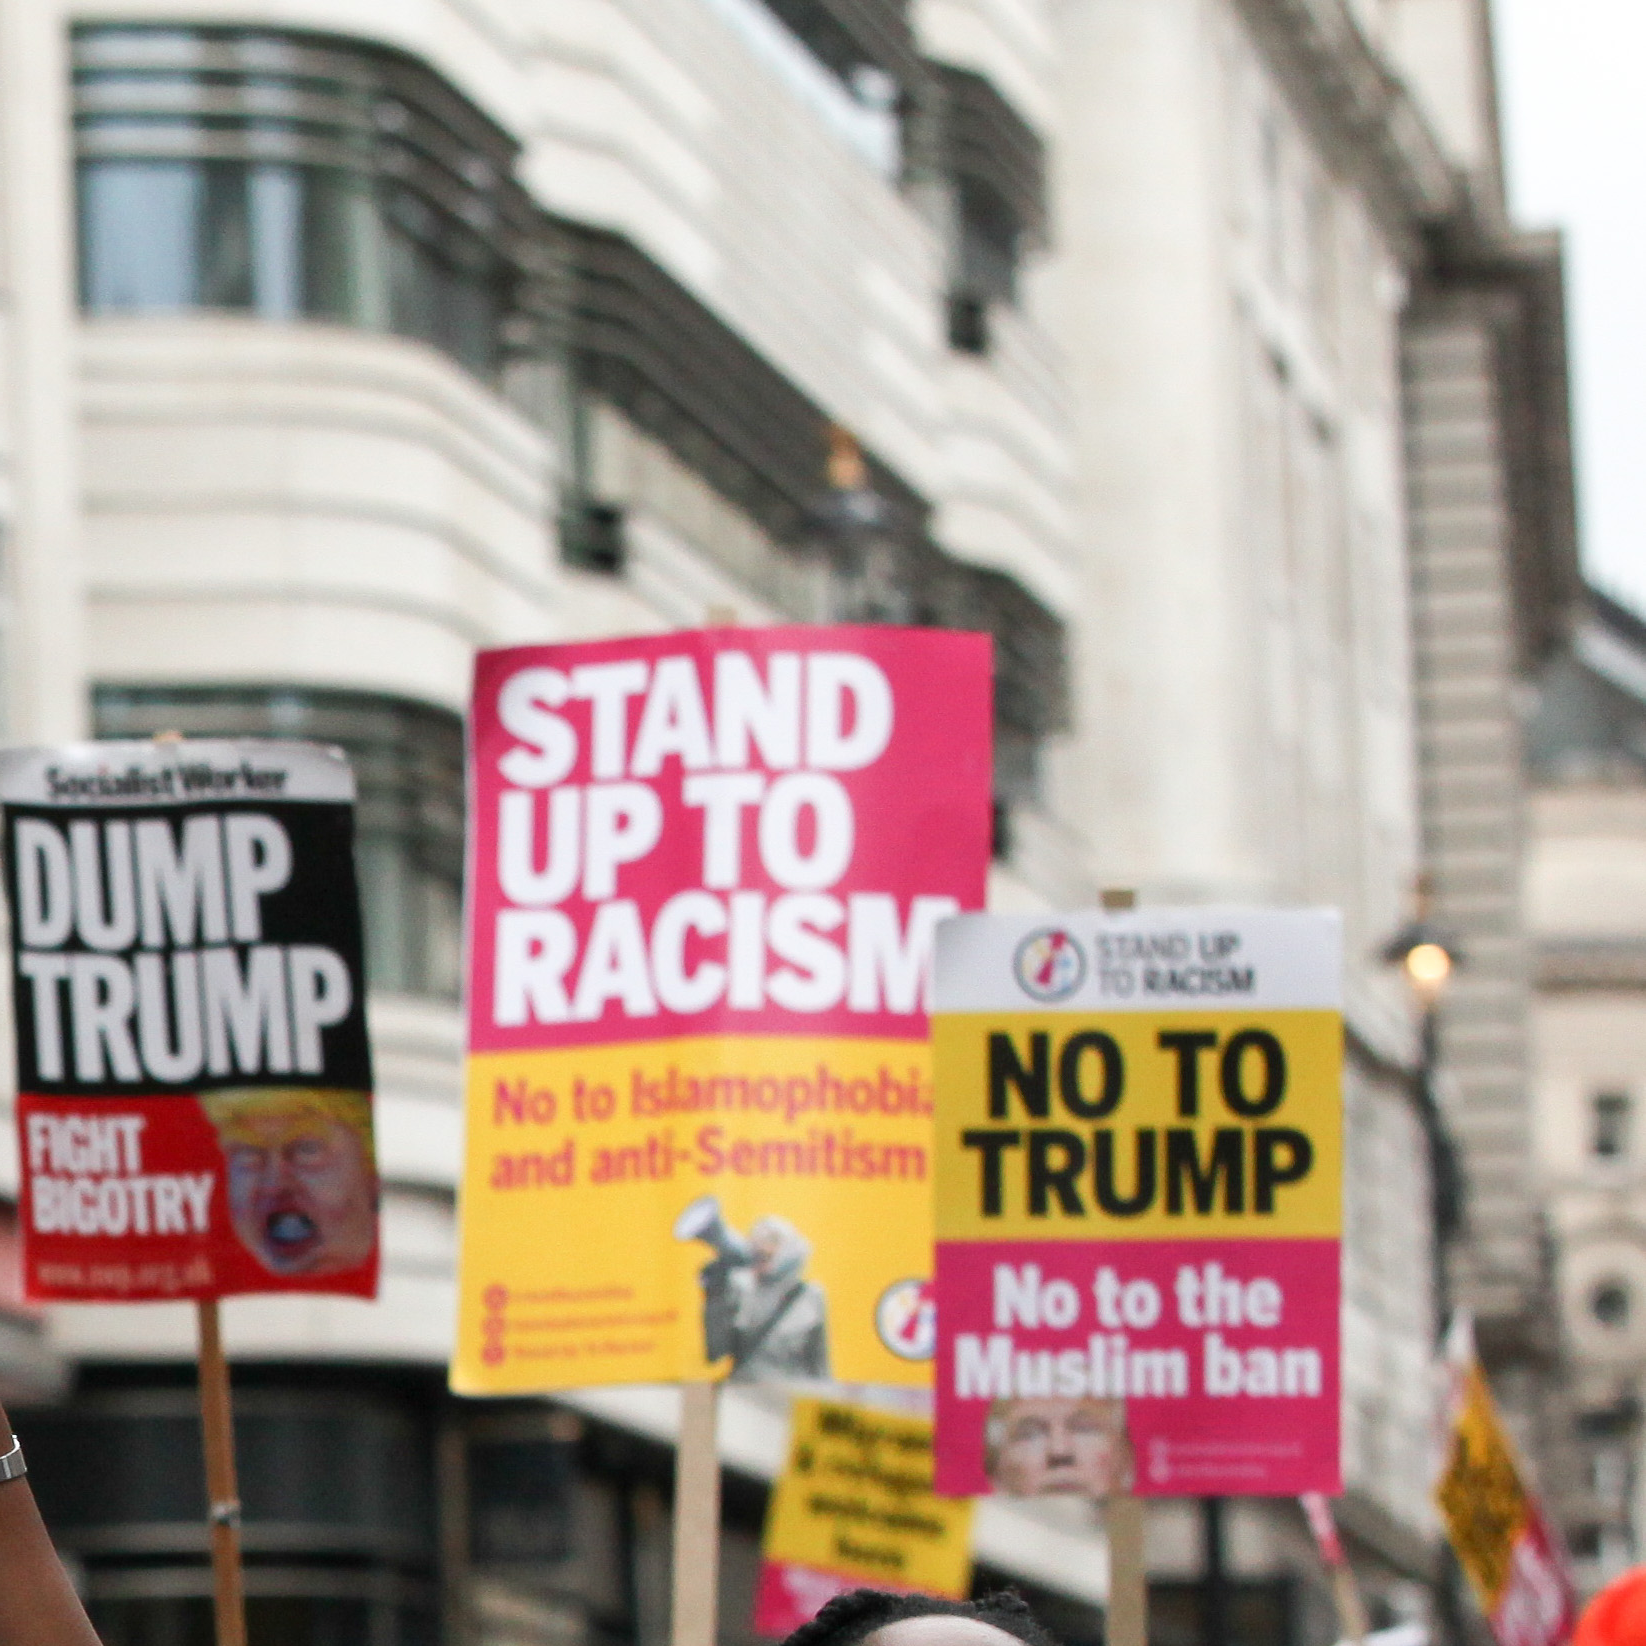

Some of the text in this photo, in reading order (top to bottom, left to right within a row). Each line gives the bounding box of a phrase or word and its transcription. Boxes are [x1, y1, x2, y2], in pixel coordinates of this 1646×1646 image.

[497, 649, 895, 789] STAND
[46, 761, 288, 796] Socialist Worker
[497, 768, 856, 908] UP TO
[14, 813, 295, 950] DUMP
[493, 889, 960, 1027] RACISM
[1096, 931, 1240, 960] STAND UP
[20, 943, 353, 1084] TRUMP
[1099, 968, 1256, 995] TO RACISM
[492, 1077, 557, 1128] No
[573, 1073, 616, 1122] to
[988, 1028, 1287, 1119] NO TO
[27, 1113, 145, 1173] FIGHT
[490, 1125, 928, 1191] and anti-Semitism
[961, 1126, 1314, 1218] TRUMP
[32, 1172, 214, 1236] BIGOTRY
[993, 1262, 1283, 1329] No to the
[954, 1332, 1322, 1398] Muslim ban
